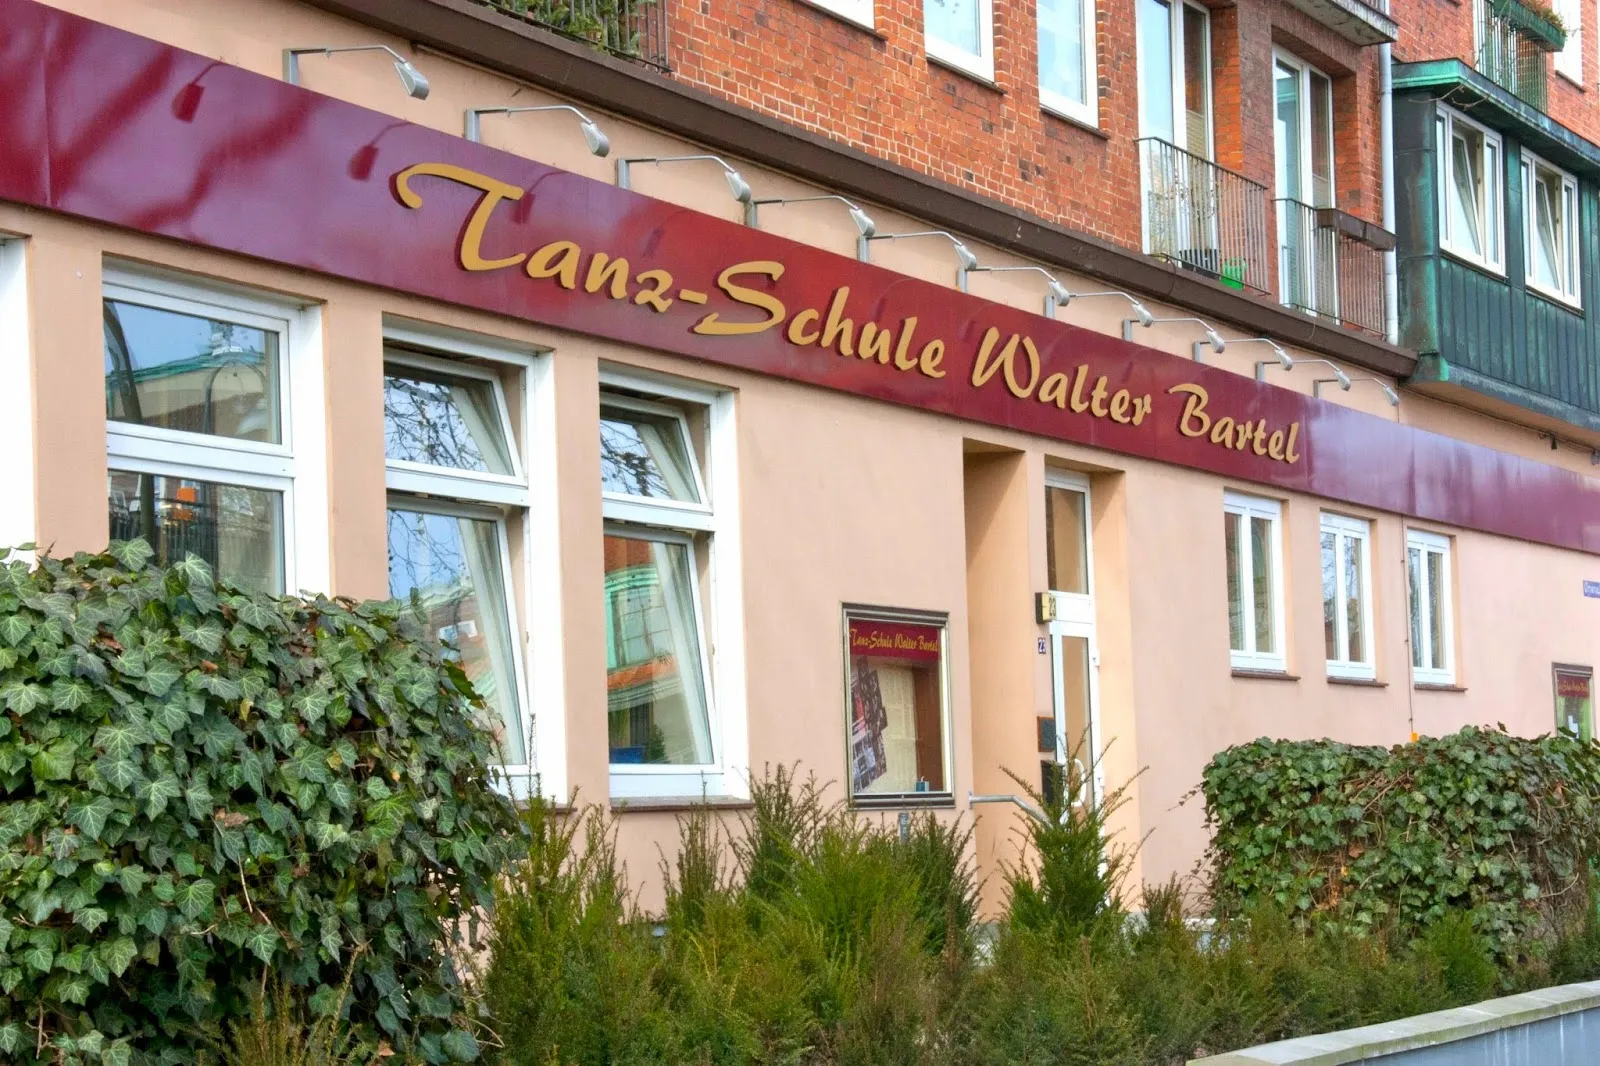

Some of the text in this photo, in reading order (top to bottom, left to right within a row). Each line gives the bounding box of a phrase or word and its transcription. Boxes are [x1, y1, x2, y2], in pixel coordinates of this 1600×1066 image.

[395, 162, 1300, 464] Tanz-Schule Walter Bartel
